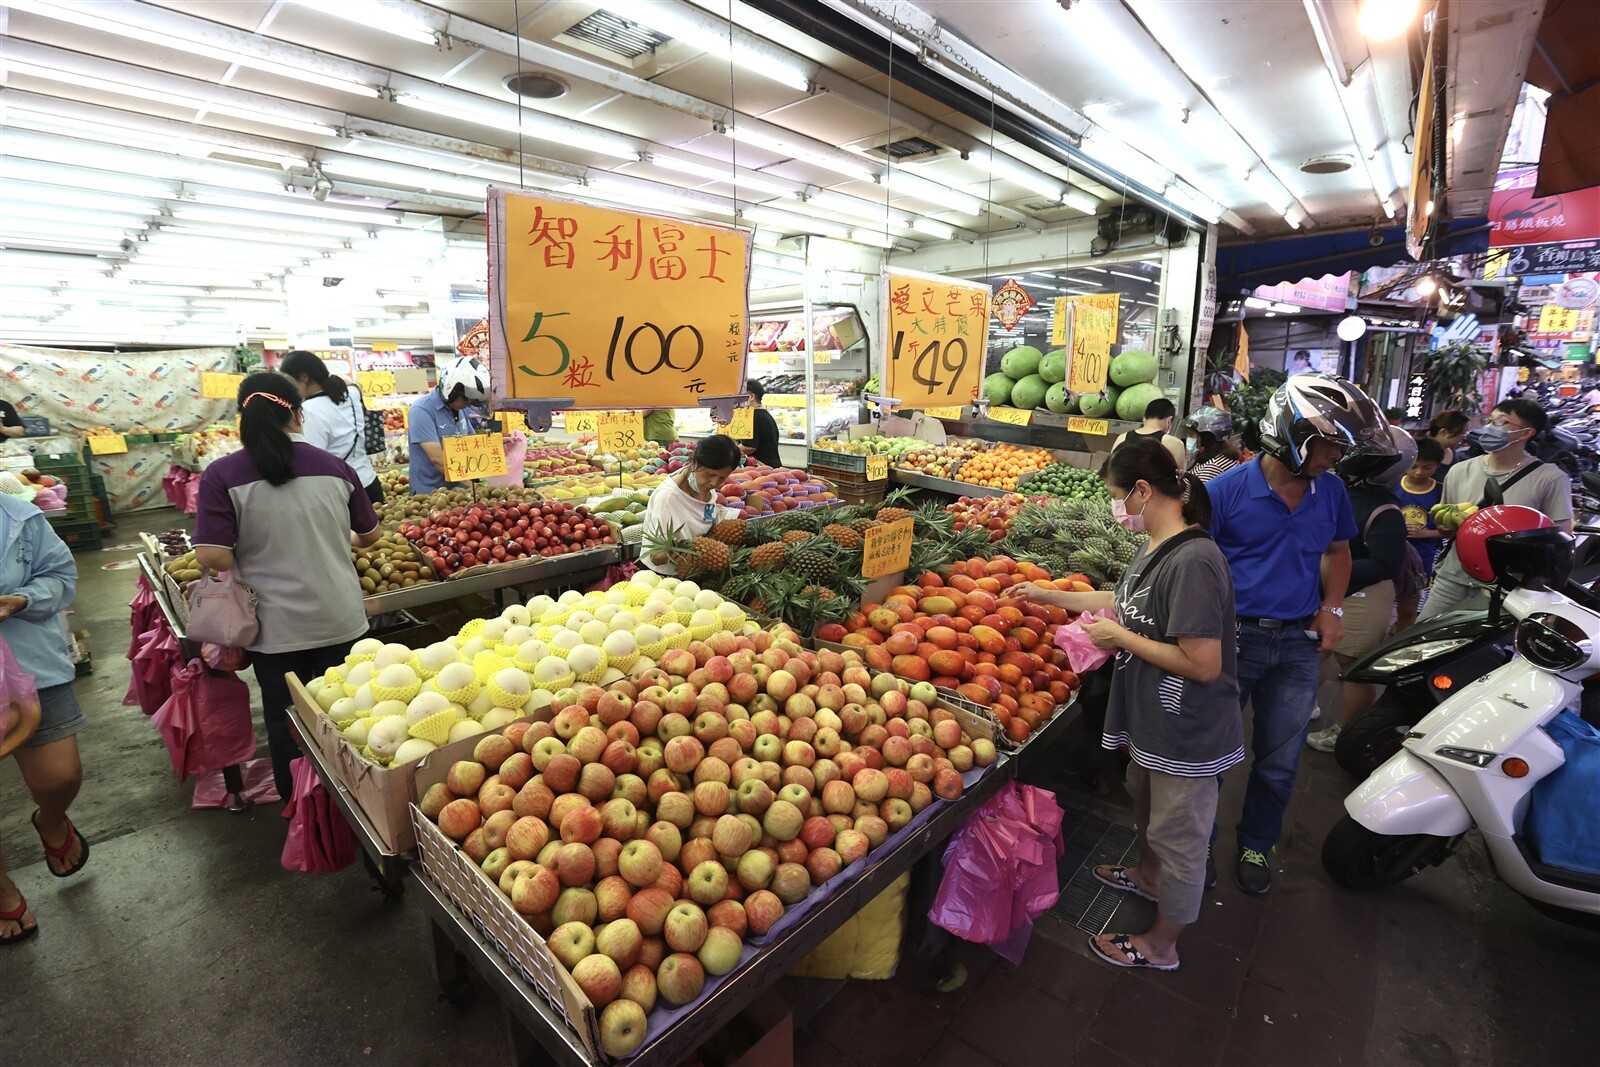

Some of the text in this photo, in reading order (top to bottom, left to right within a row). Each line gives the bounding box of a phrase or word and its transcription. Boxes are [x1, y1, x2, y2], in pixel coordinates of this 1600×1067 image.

[528, 206, 732, 283] 智利富士
[891, 284, 987, 319] 愛文芒果
[910, 314, 970, 336] 大特價
[606, 316, 704, 381] 100
[912, 338, 968, 396] 49
[614, 429, 635, 448] 38
